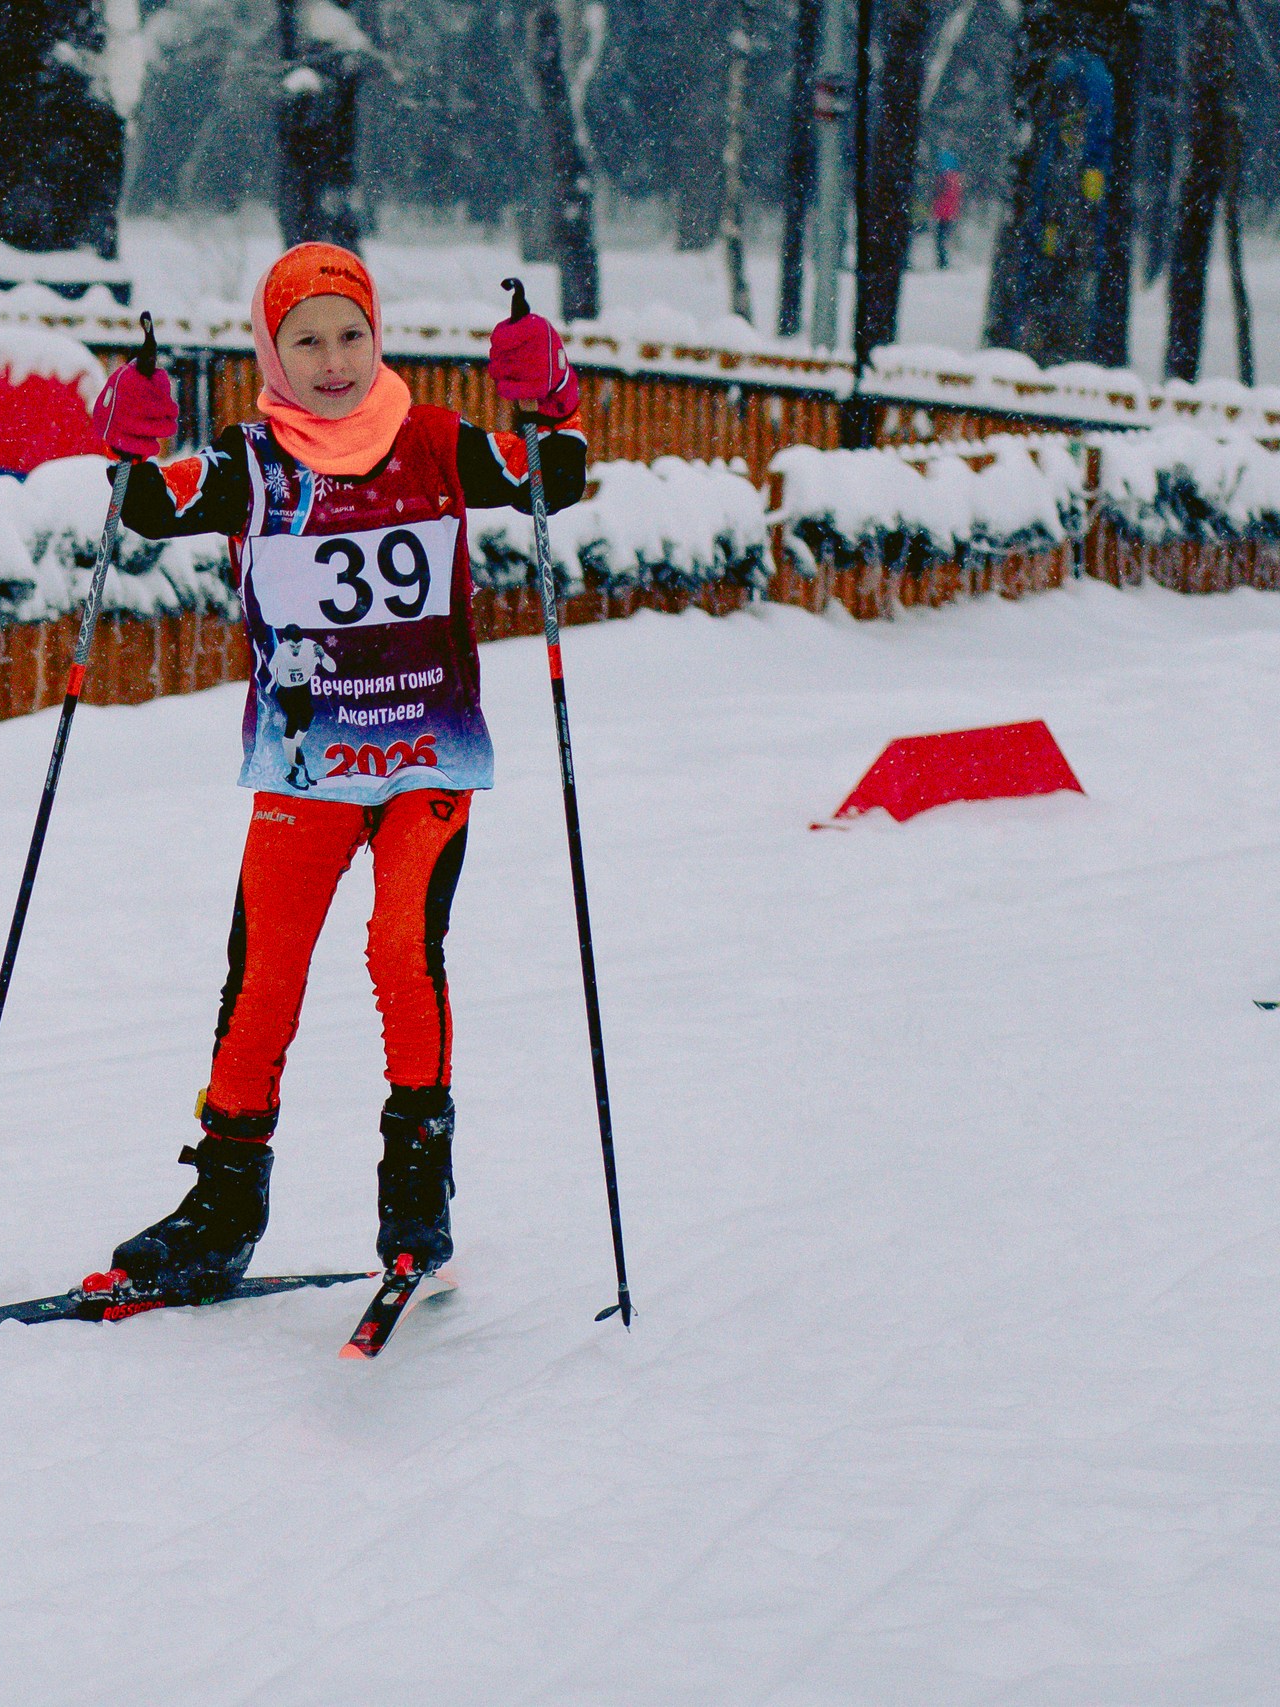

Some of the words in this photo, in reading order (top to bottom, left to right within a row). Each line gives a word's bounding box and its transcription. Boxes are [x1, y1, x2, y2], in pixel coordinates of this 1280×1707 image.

[314, 528, 432, 625] 39
[310, 674, 395, 700] Вечерняя
[400, 667, 443, 691] гонка
[337, 702, 425, 727] Акентьева
[324, 733, 438, 778] 2026
